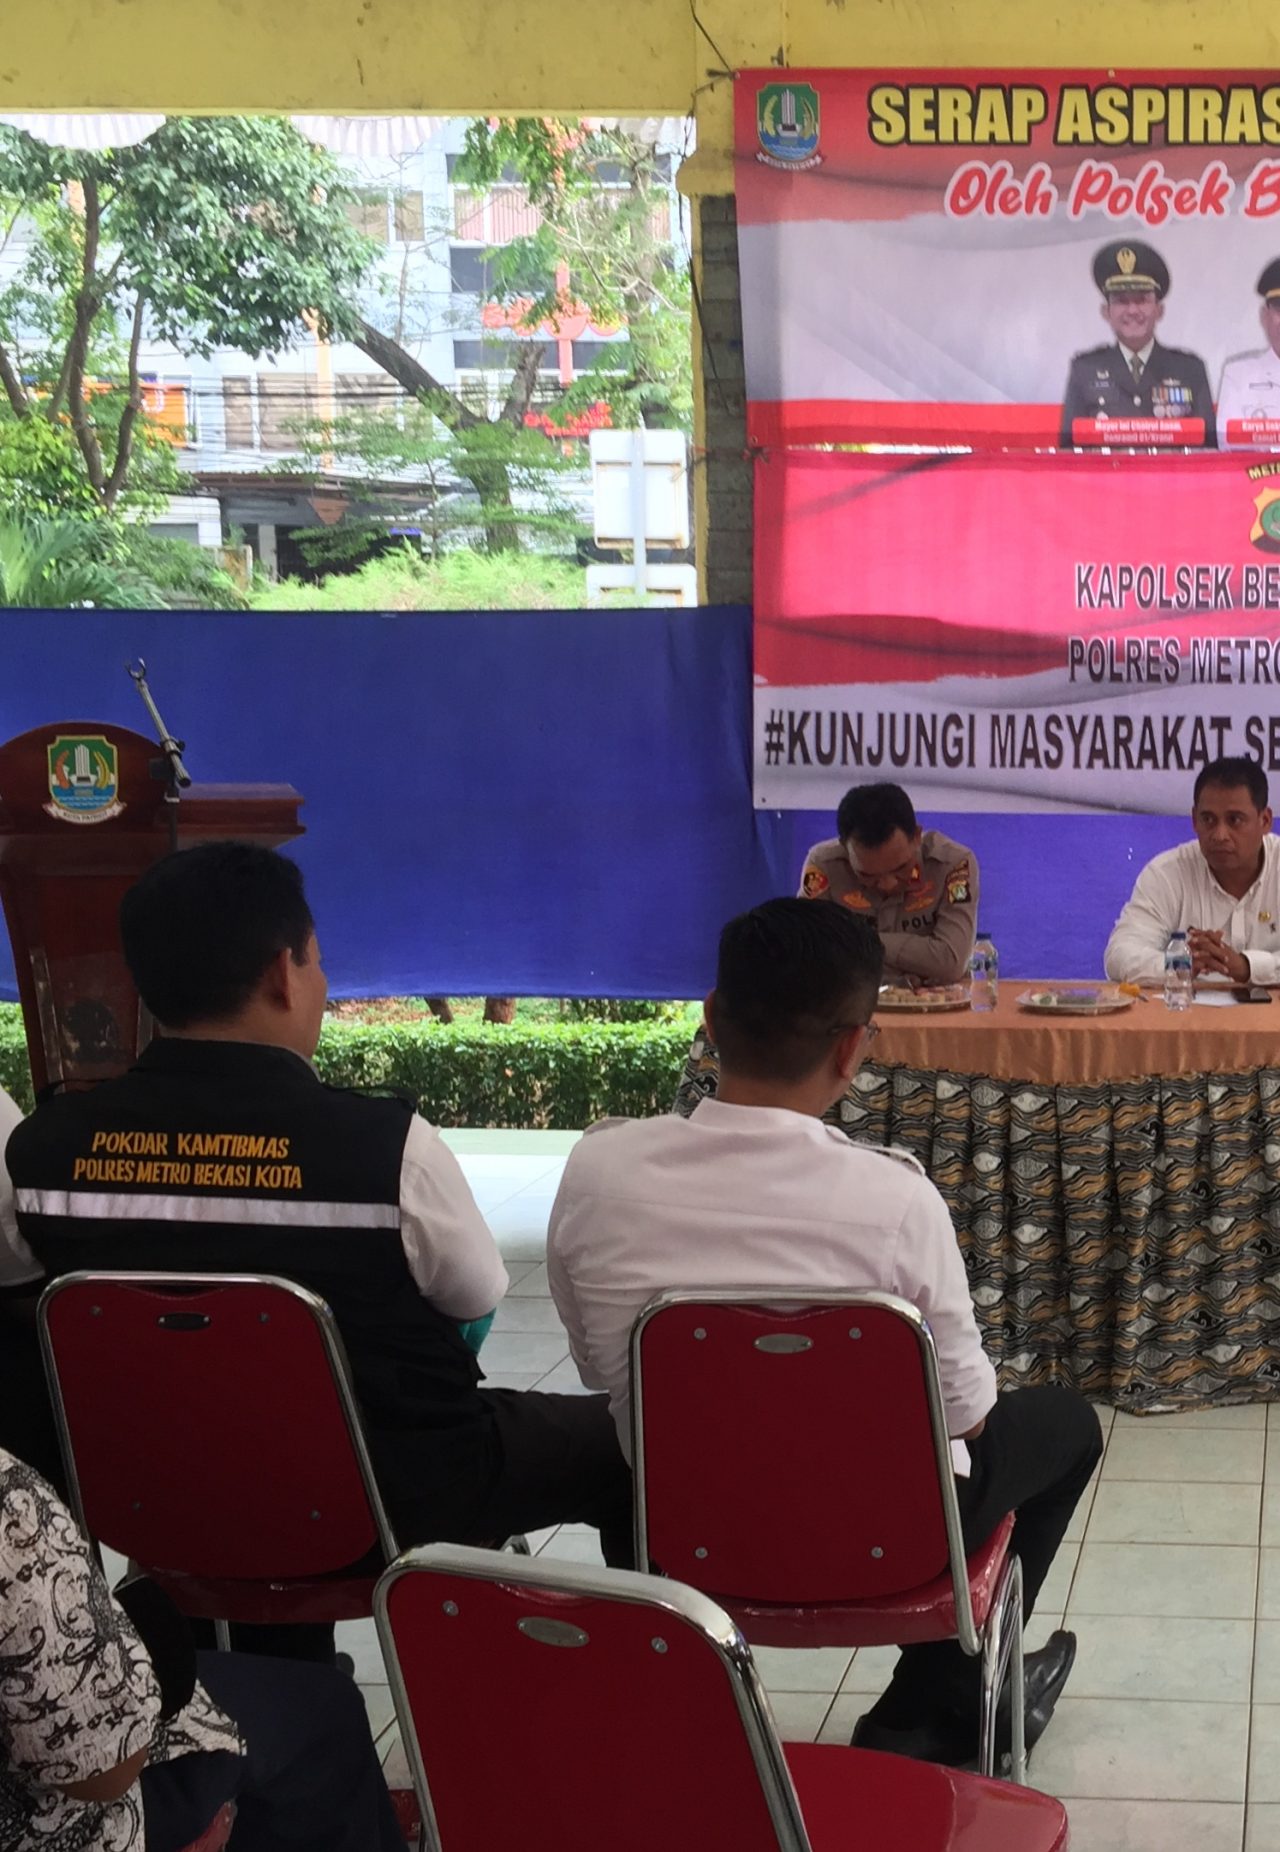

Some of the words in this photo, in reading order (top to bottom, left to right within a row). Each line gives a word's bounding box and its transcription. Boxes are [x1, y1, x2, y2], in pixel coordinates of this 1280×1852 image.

[869, 86, 1047, 145] SERAP
[949, 165, 1051, 217] Oleh
[1072, 164, 1231, 225] Polsek
[1075, 564, 1232, 610] KAPOLSEK
[1068, 638, 1180, 684] POLRES
[765, 710, 976, 769] #KUNJUNGI
[990, 714, 1232, 771] MASYARAKAT
[92, 1131, 168, 1155] POKDAR
[177, 1133, 290, 1159] KAMTIBMAS
[73, 1158, 135, 1182] POLRES
[136, 1161, 191, 1185] METRO
[193, 1164, 251, 1188] BEKASI
[254, 1165, 303, 1189] KOTA
